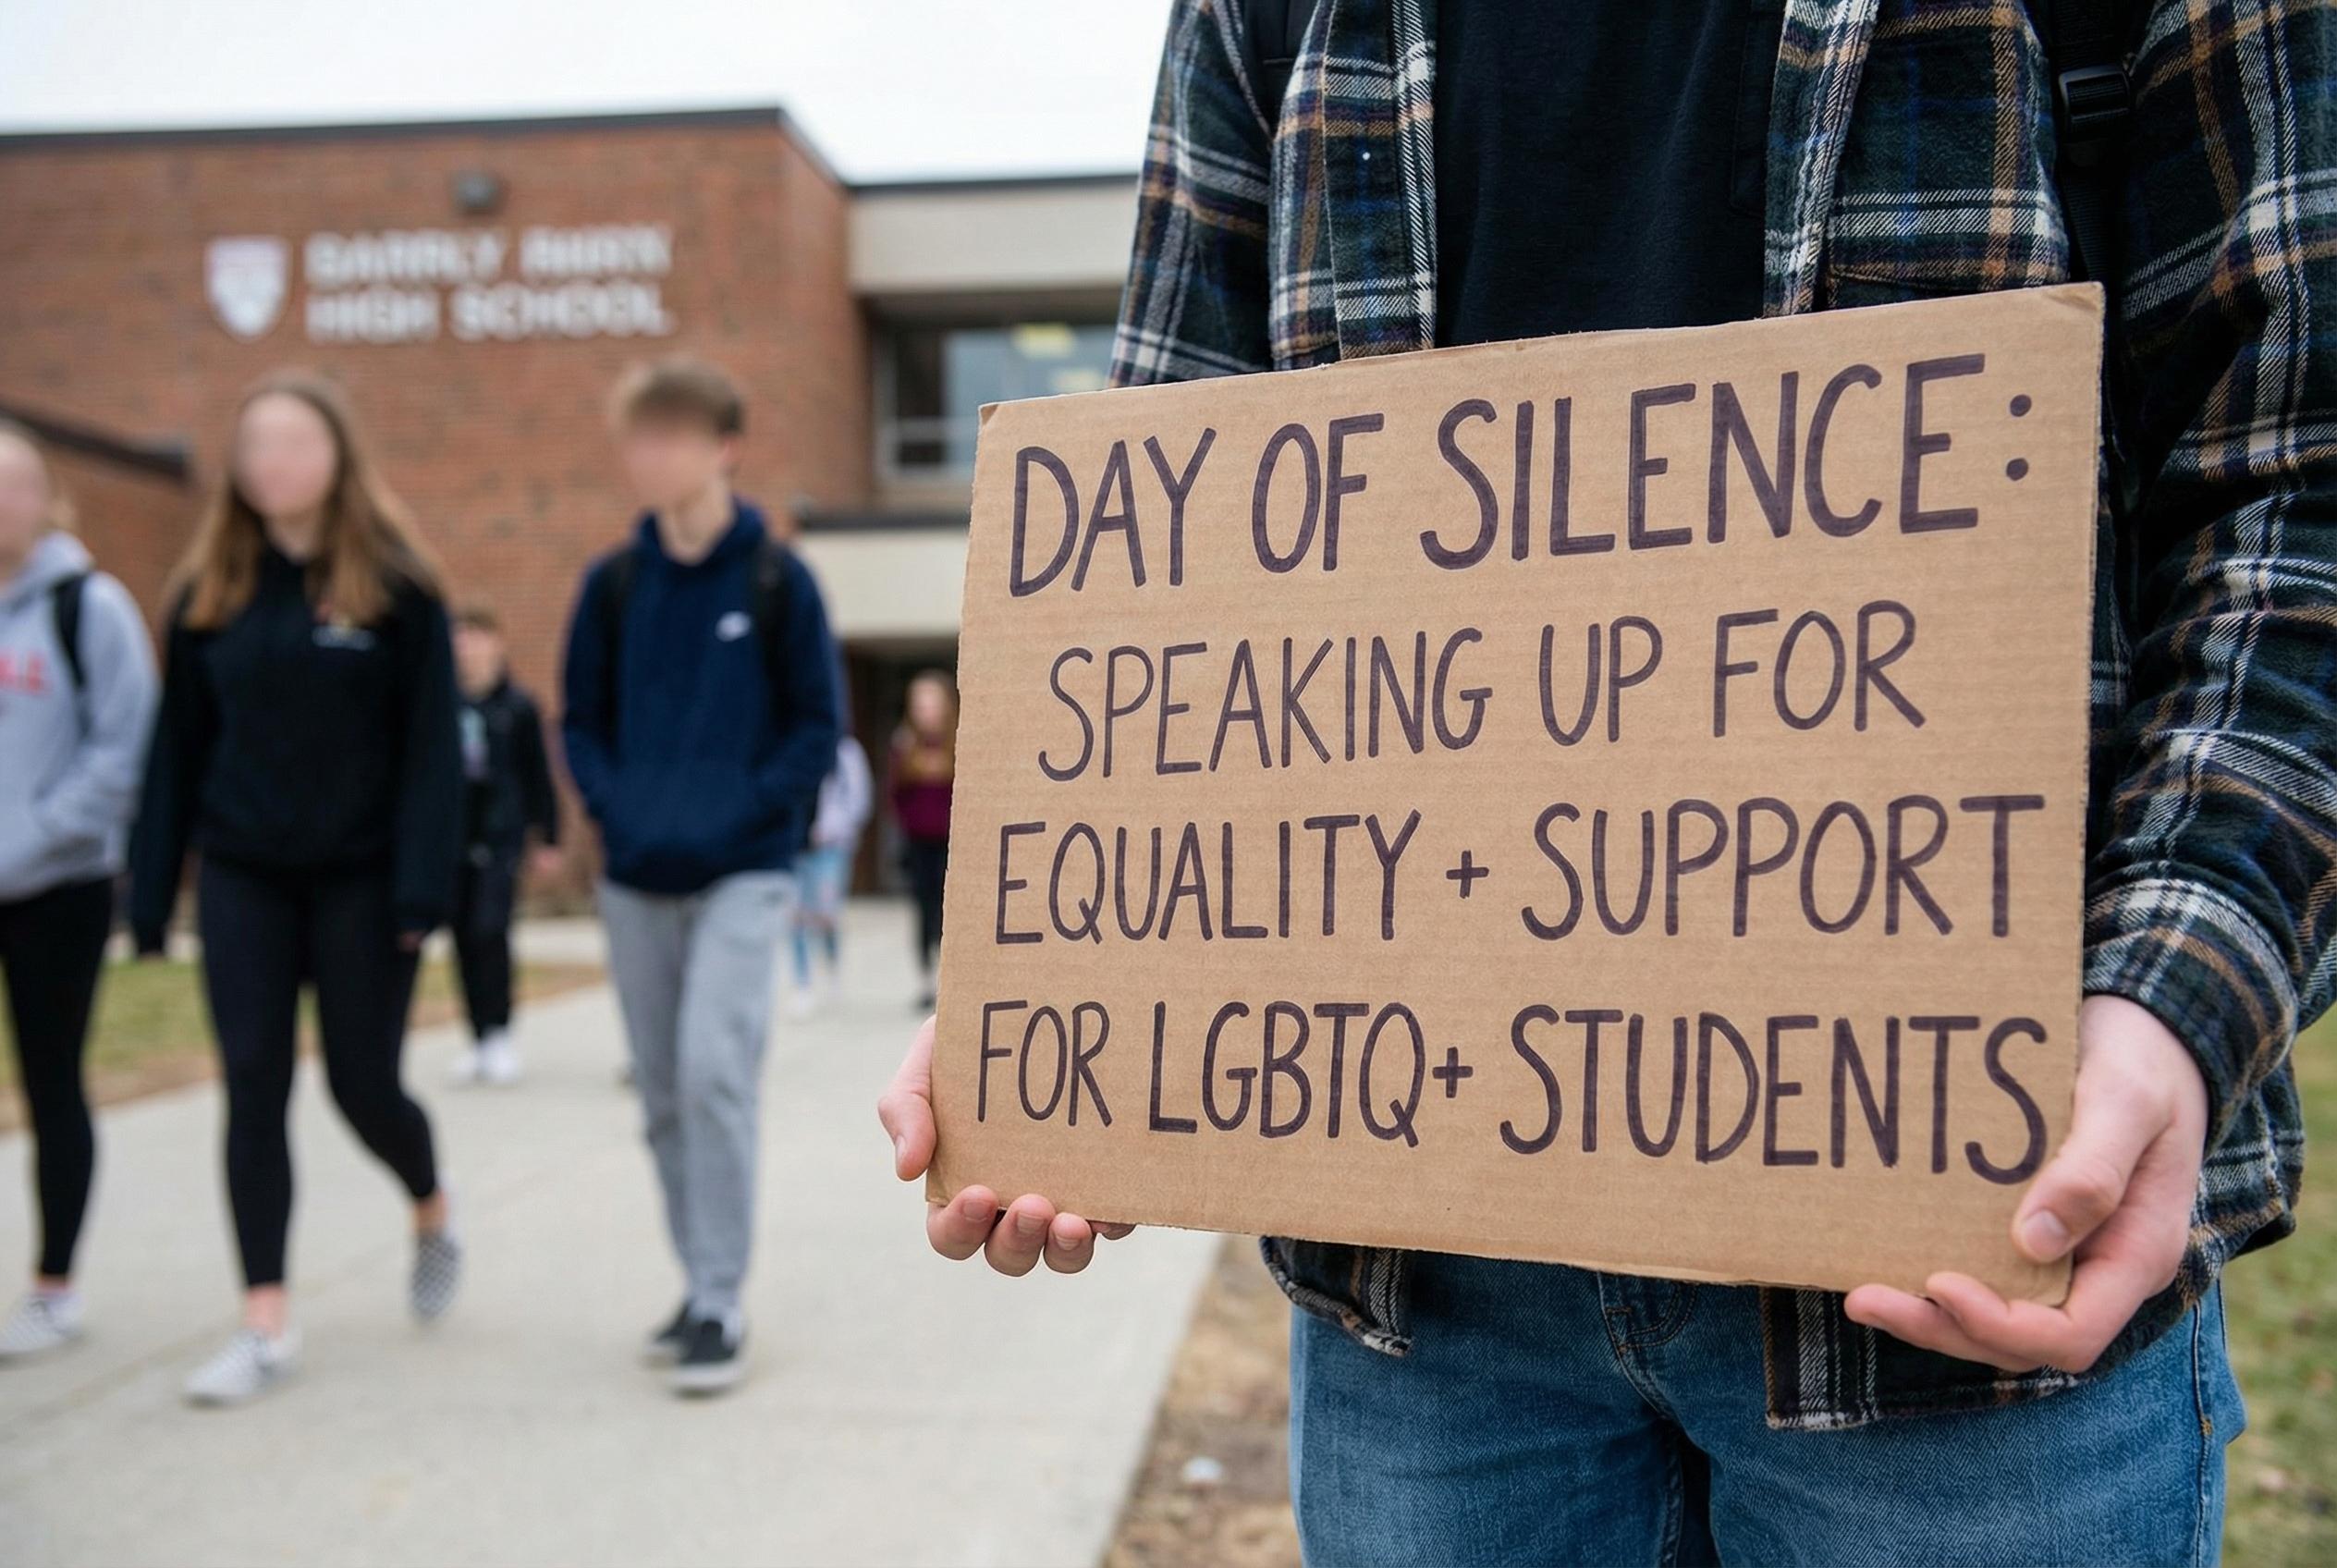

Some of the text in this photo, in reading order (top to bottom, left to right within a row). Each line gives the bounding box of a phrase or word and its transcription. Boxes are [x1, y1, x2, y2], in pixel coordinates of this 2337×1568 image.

[306, 279, 677, 343] HIGH SCHOOL
[1009, 354, 2031, 596] DAY OF SILENCE:
[1039, 601, 1925, 781] SPEAKING UP FOR
[997, 795, 2045, 944] EQUALITY + SUPPORT
[978, 1000, 2047, 1185] FOR LGBTQ+ STUDENTS
